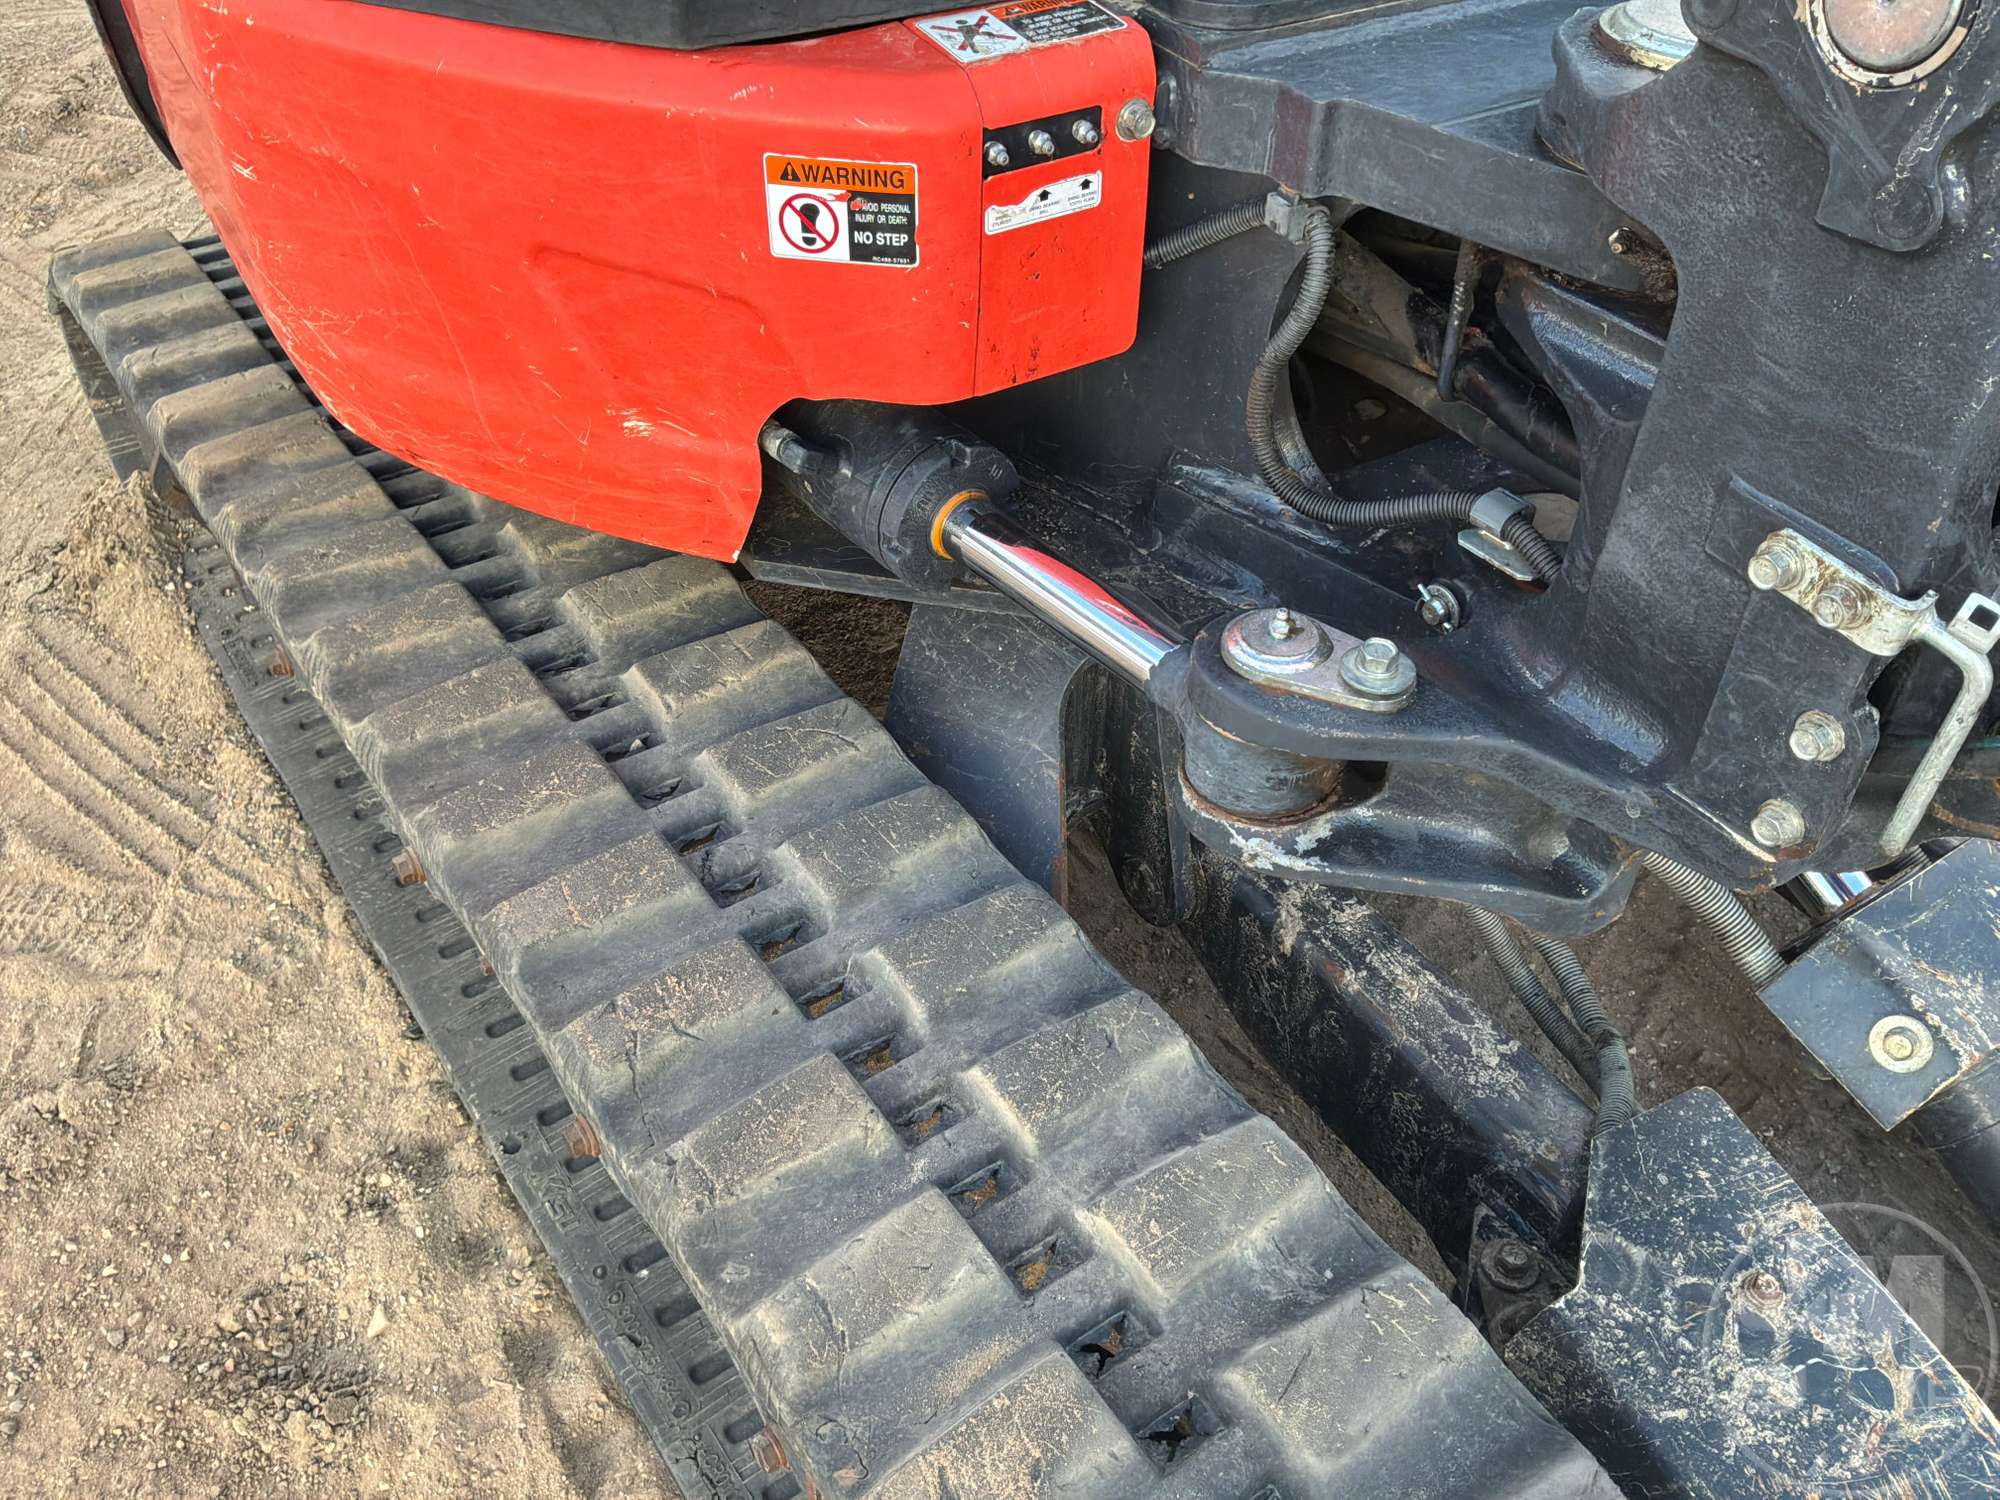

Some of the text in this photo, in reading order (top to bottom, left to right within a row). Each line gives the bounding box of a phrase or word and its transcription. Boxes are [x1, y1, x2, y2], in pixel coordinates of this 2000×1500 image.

[801, 163, 905, 189] WARNING
[880, 203, 911, 214] PERSONAL
[855, 213, 875, 224] INJURY
[877, 214, 886, 224] OR
[854, 230, 909, 246] NO STEP
